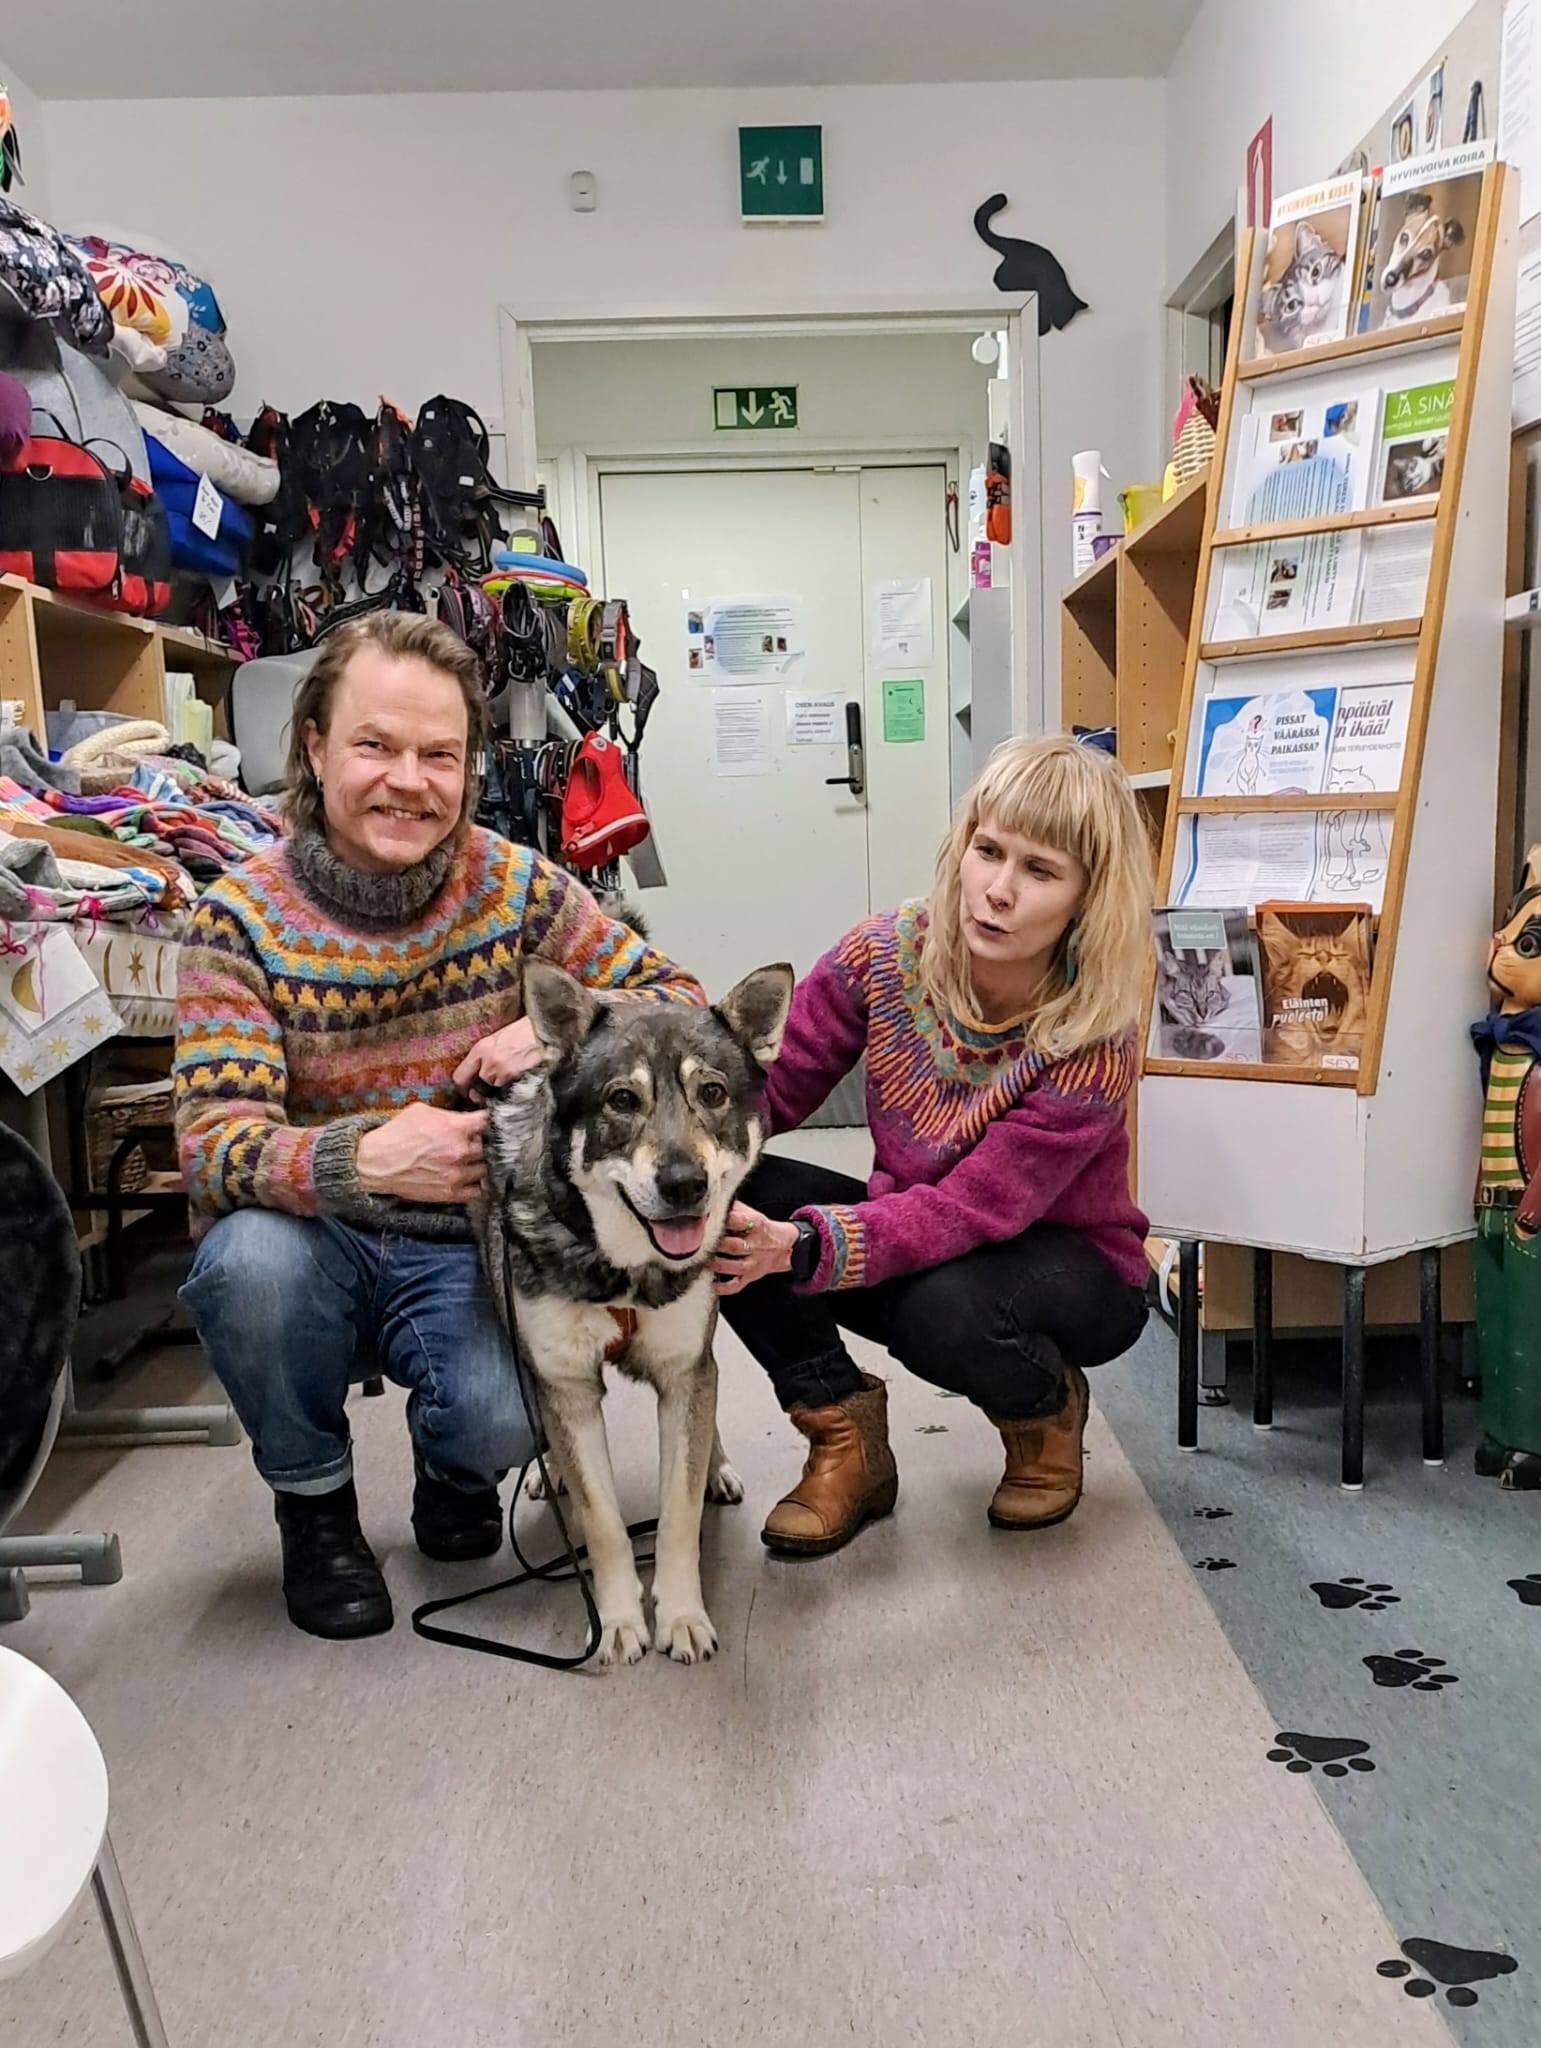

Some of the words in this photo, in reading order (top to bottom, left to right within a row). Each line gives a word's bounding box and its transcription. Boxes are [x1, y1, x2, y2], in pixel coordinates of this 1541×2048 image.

[1390, 158, 1451, 183] HYVINVOIVA
[1453, 150, 1485, 165] KOIRA
[1275, 714, 1307, 726] PISSAT
[1273, 725, 1320, 740] VÄÄRÄSSÄ
[1349, 719, 1391, 737] ikää!
[1271, 742, 1320, 755] PAIKASSA?
[1282, 997, 1329, 1010] Eläinten
